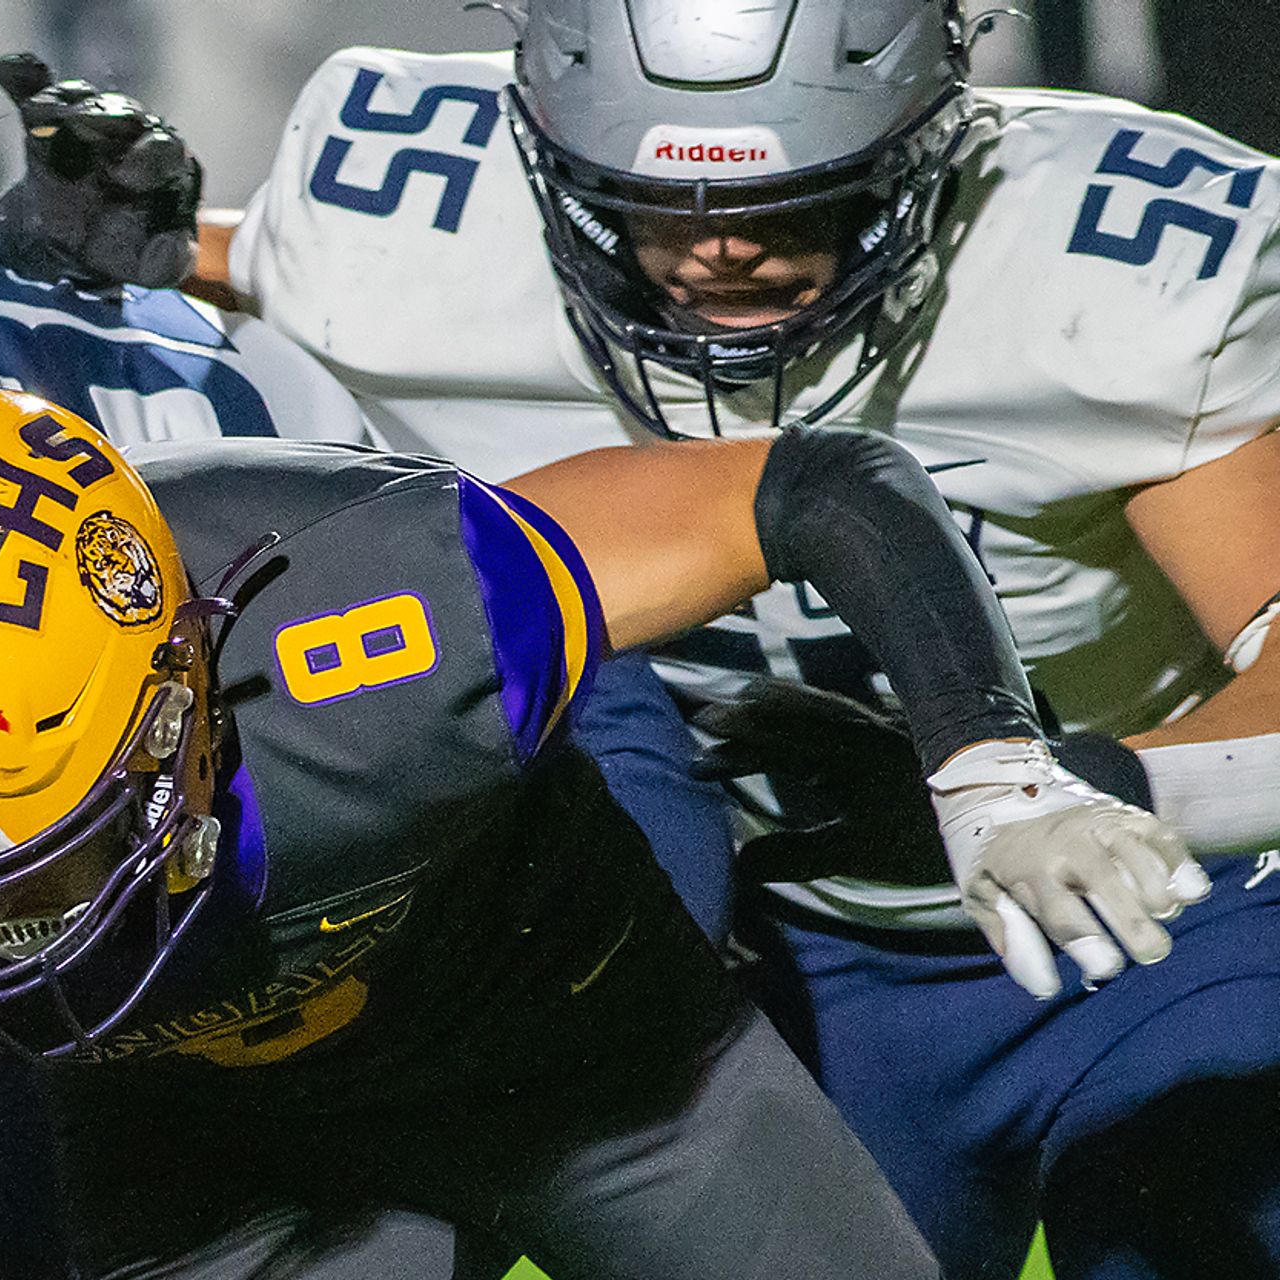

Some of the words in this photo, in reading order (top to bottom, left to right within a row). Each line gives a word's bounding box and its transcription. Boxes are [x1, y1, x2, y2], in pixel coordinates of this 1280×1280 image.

[310, 67, 500, 233] 55
[654, 141, 768, 163] Riddell
[1066, 127, 1266, 281] 55
[275, 591, 441, 706] 8
